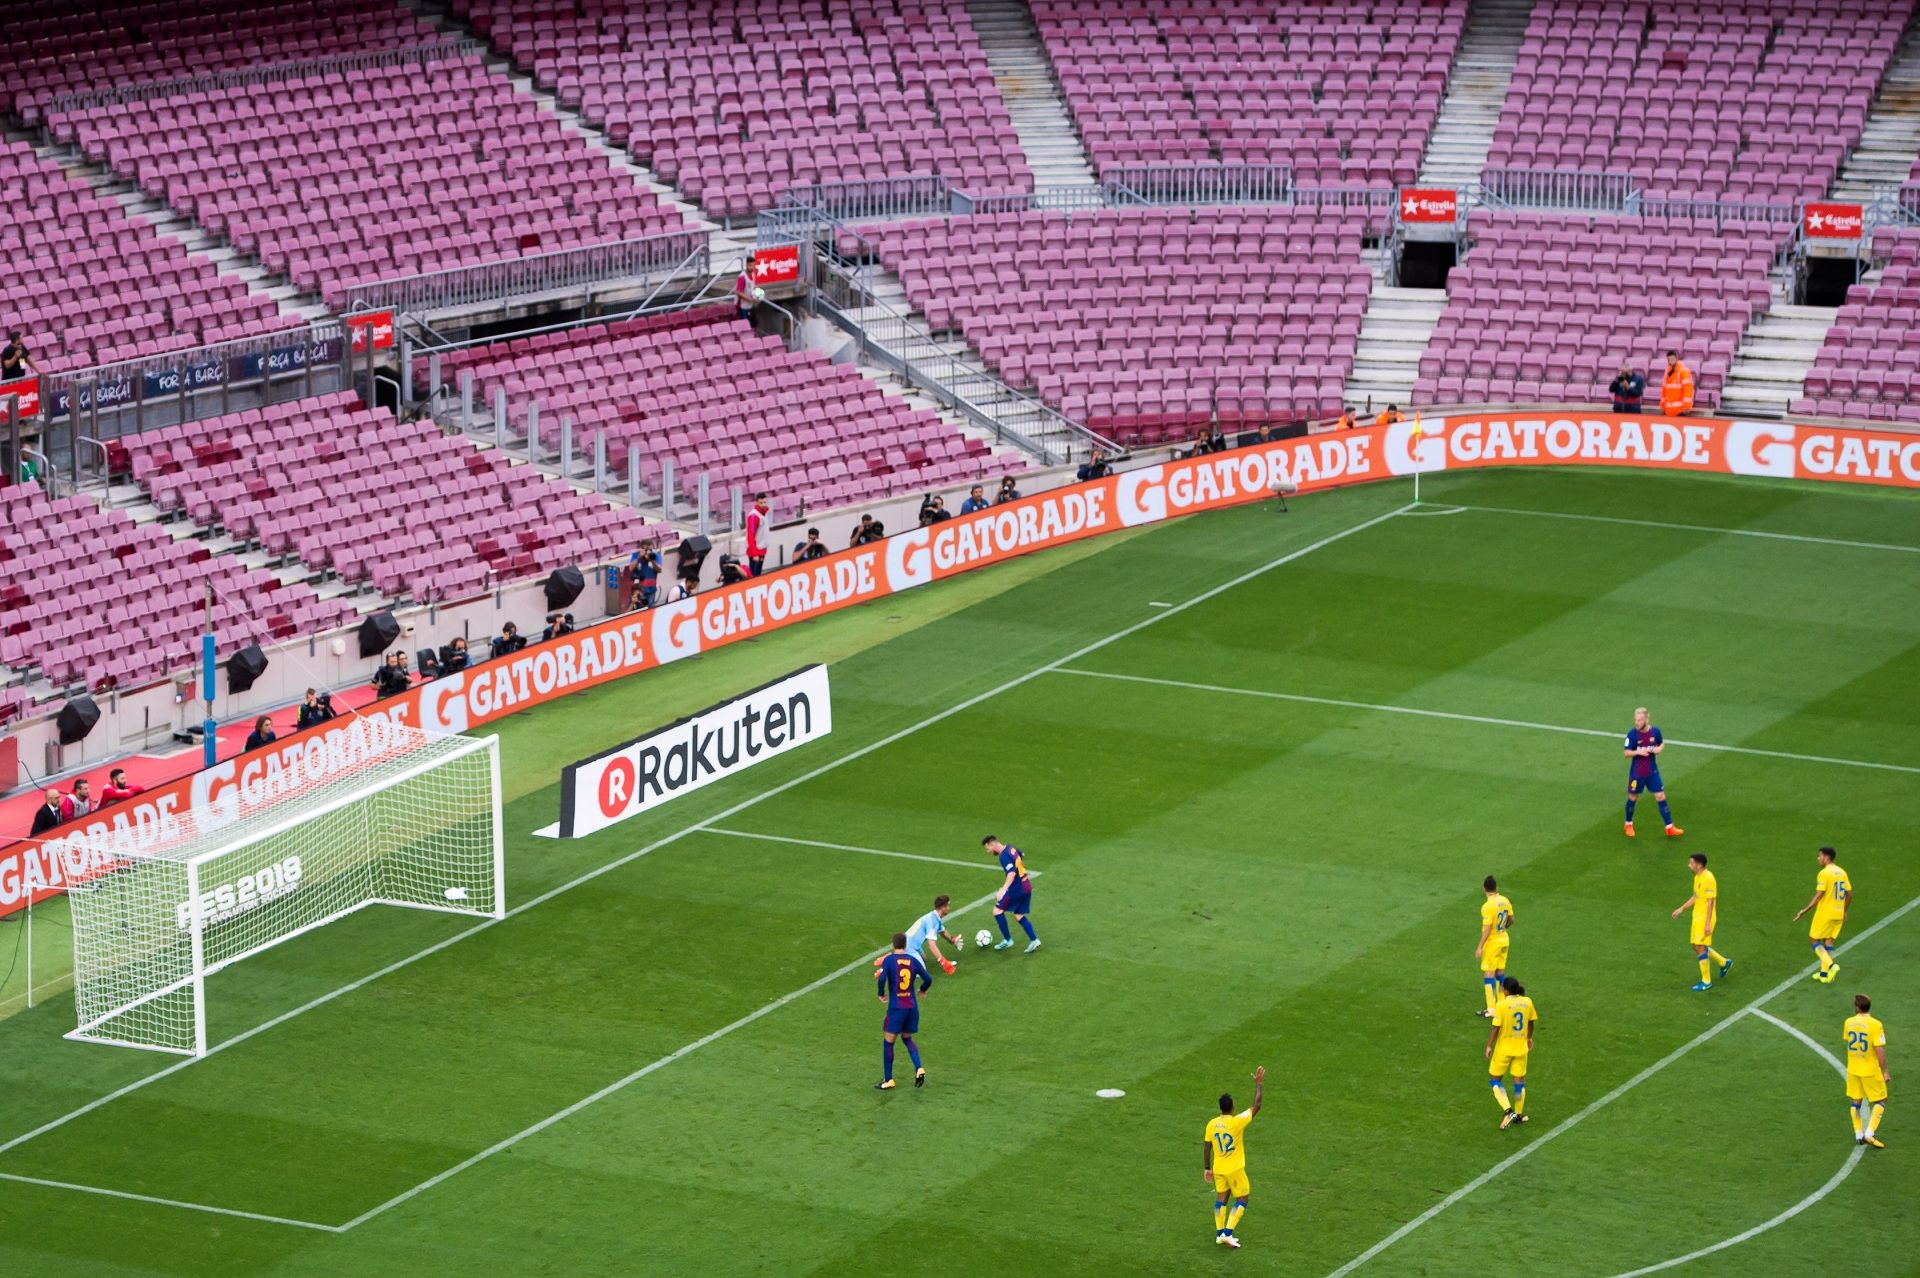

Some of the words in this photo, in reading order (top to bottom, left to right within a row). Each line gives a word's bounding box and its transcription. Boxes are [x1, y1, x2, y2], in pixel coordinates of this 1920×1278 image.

[159, 372, 191, 390] FORA
[257, 350, 289, 370] FRÇA
[293, 343, 329, 363] BAÇA!
[1168, 435, 1370, 507] GATORADE
[1450, 419, 1710, 465] GATORADE
[933, 487, 1106, 570] GATORADE
[702, 552, 876, 641] GATORADE
[469, 623, 644, 717] GATORADE
[240, 702, 409, 805] GATORADE
[638, 692, 811, 804] Rakuten
[0, 792, 180, 906] GATORADE
[177, 884, 236, 930] PES
[237, 855, 302, 904] 2018
[1834, 881, 1847, 901] 15
[899, 968, 911, 990] 3
[1512, 1011, 1524, 1032] 3
[1848, 1030, 1869, 1053] 25
[1214, 1132, 1236, 1153] 12
